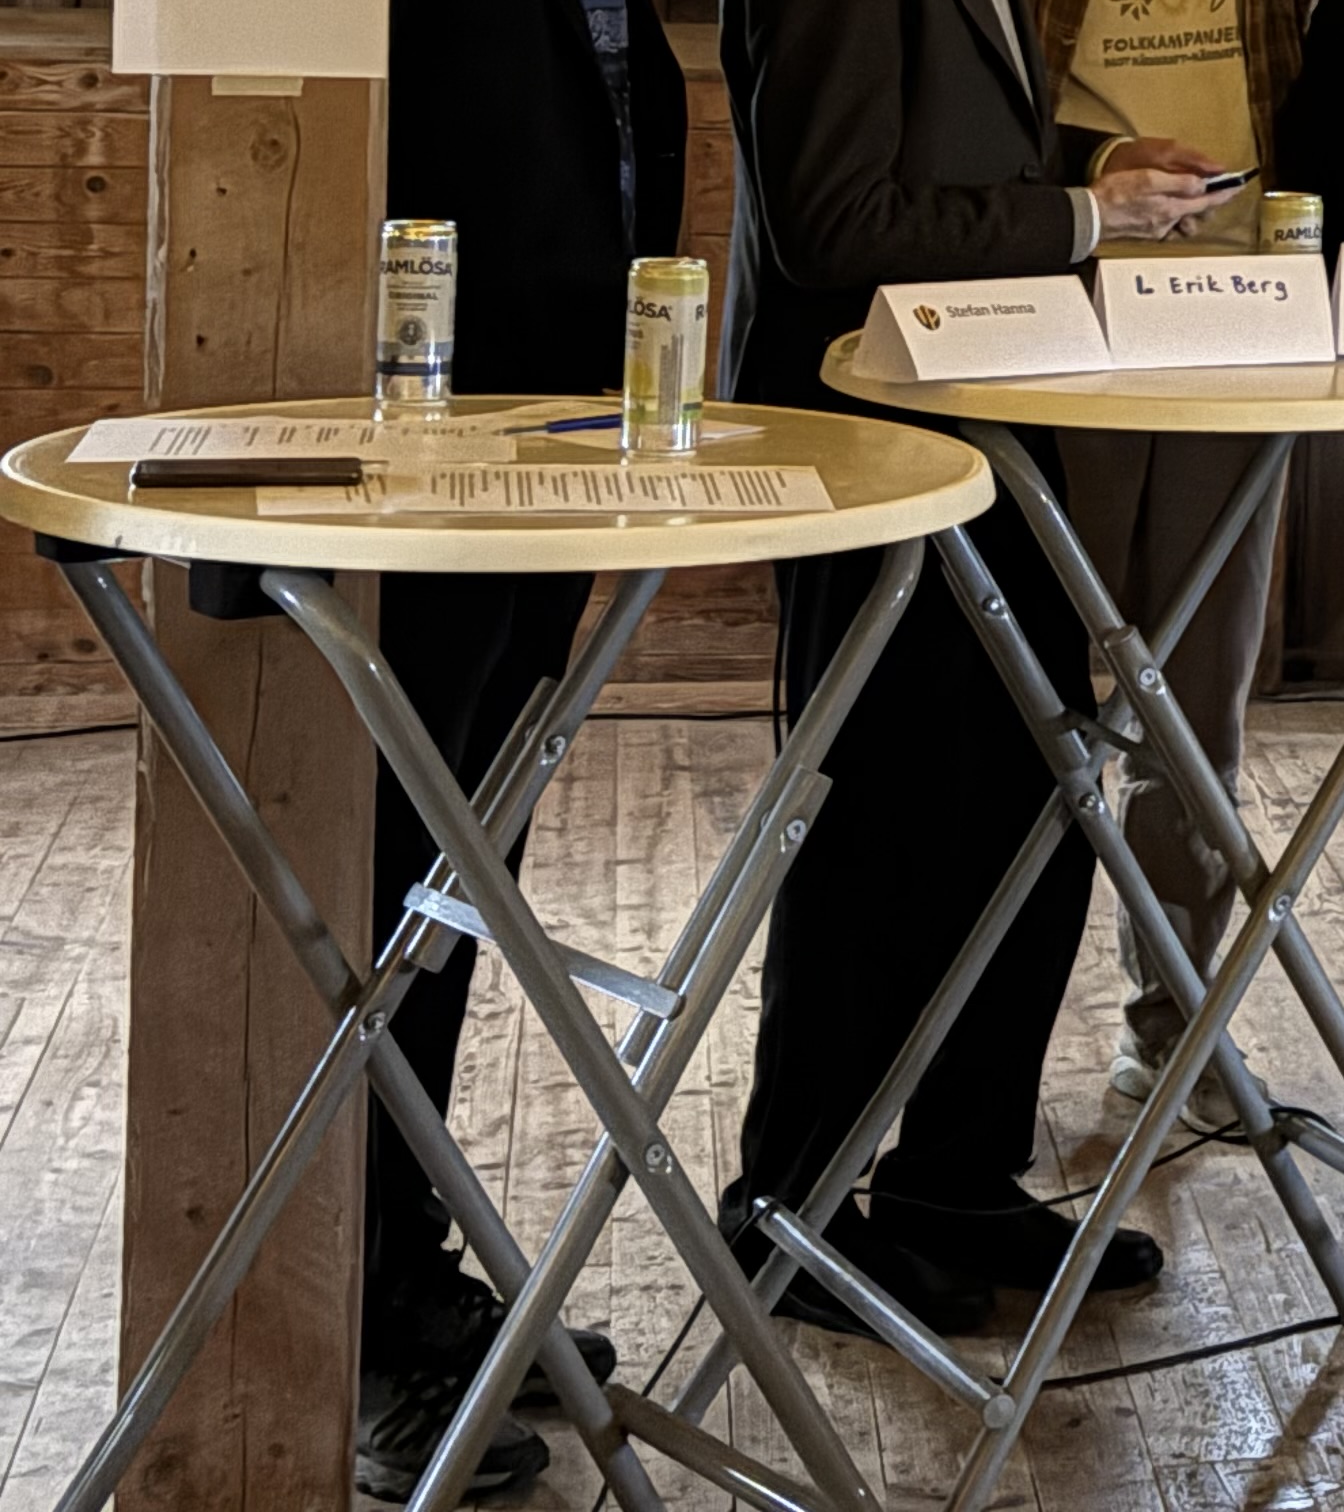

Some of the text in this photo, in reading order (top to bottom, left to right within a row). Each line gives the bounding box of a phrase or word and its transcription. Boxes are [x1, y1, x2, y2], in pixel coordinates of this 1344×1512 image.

[1169, 274, 1224, 294] Erik
[1231, 275, 1288, 301] Berg
[945, 303, 1036, 318] Stefan Hanna
